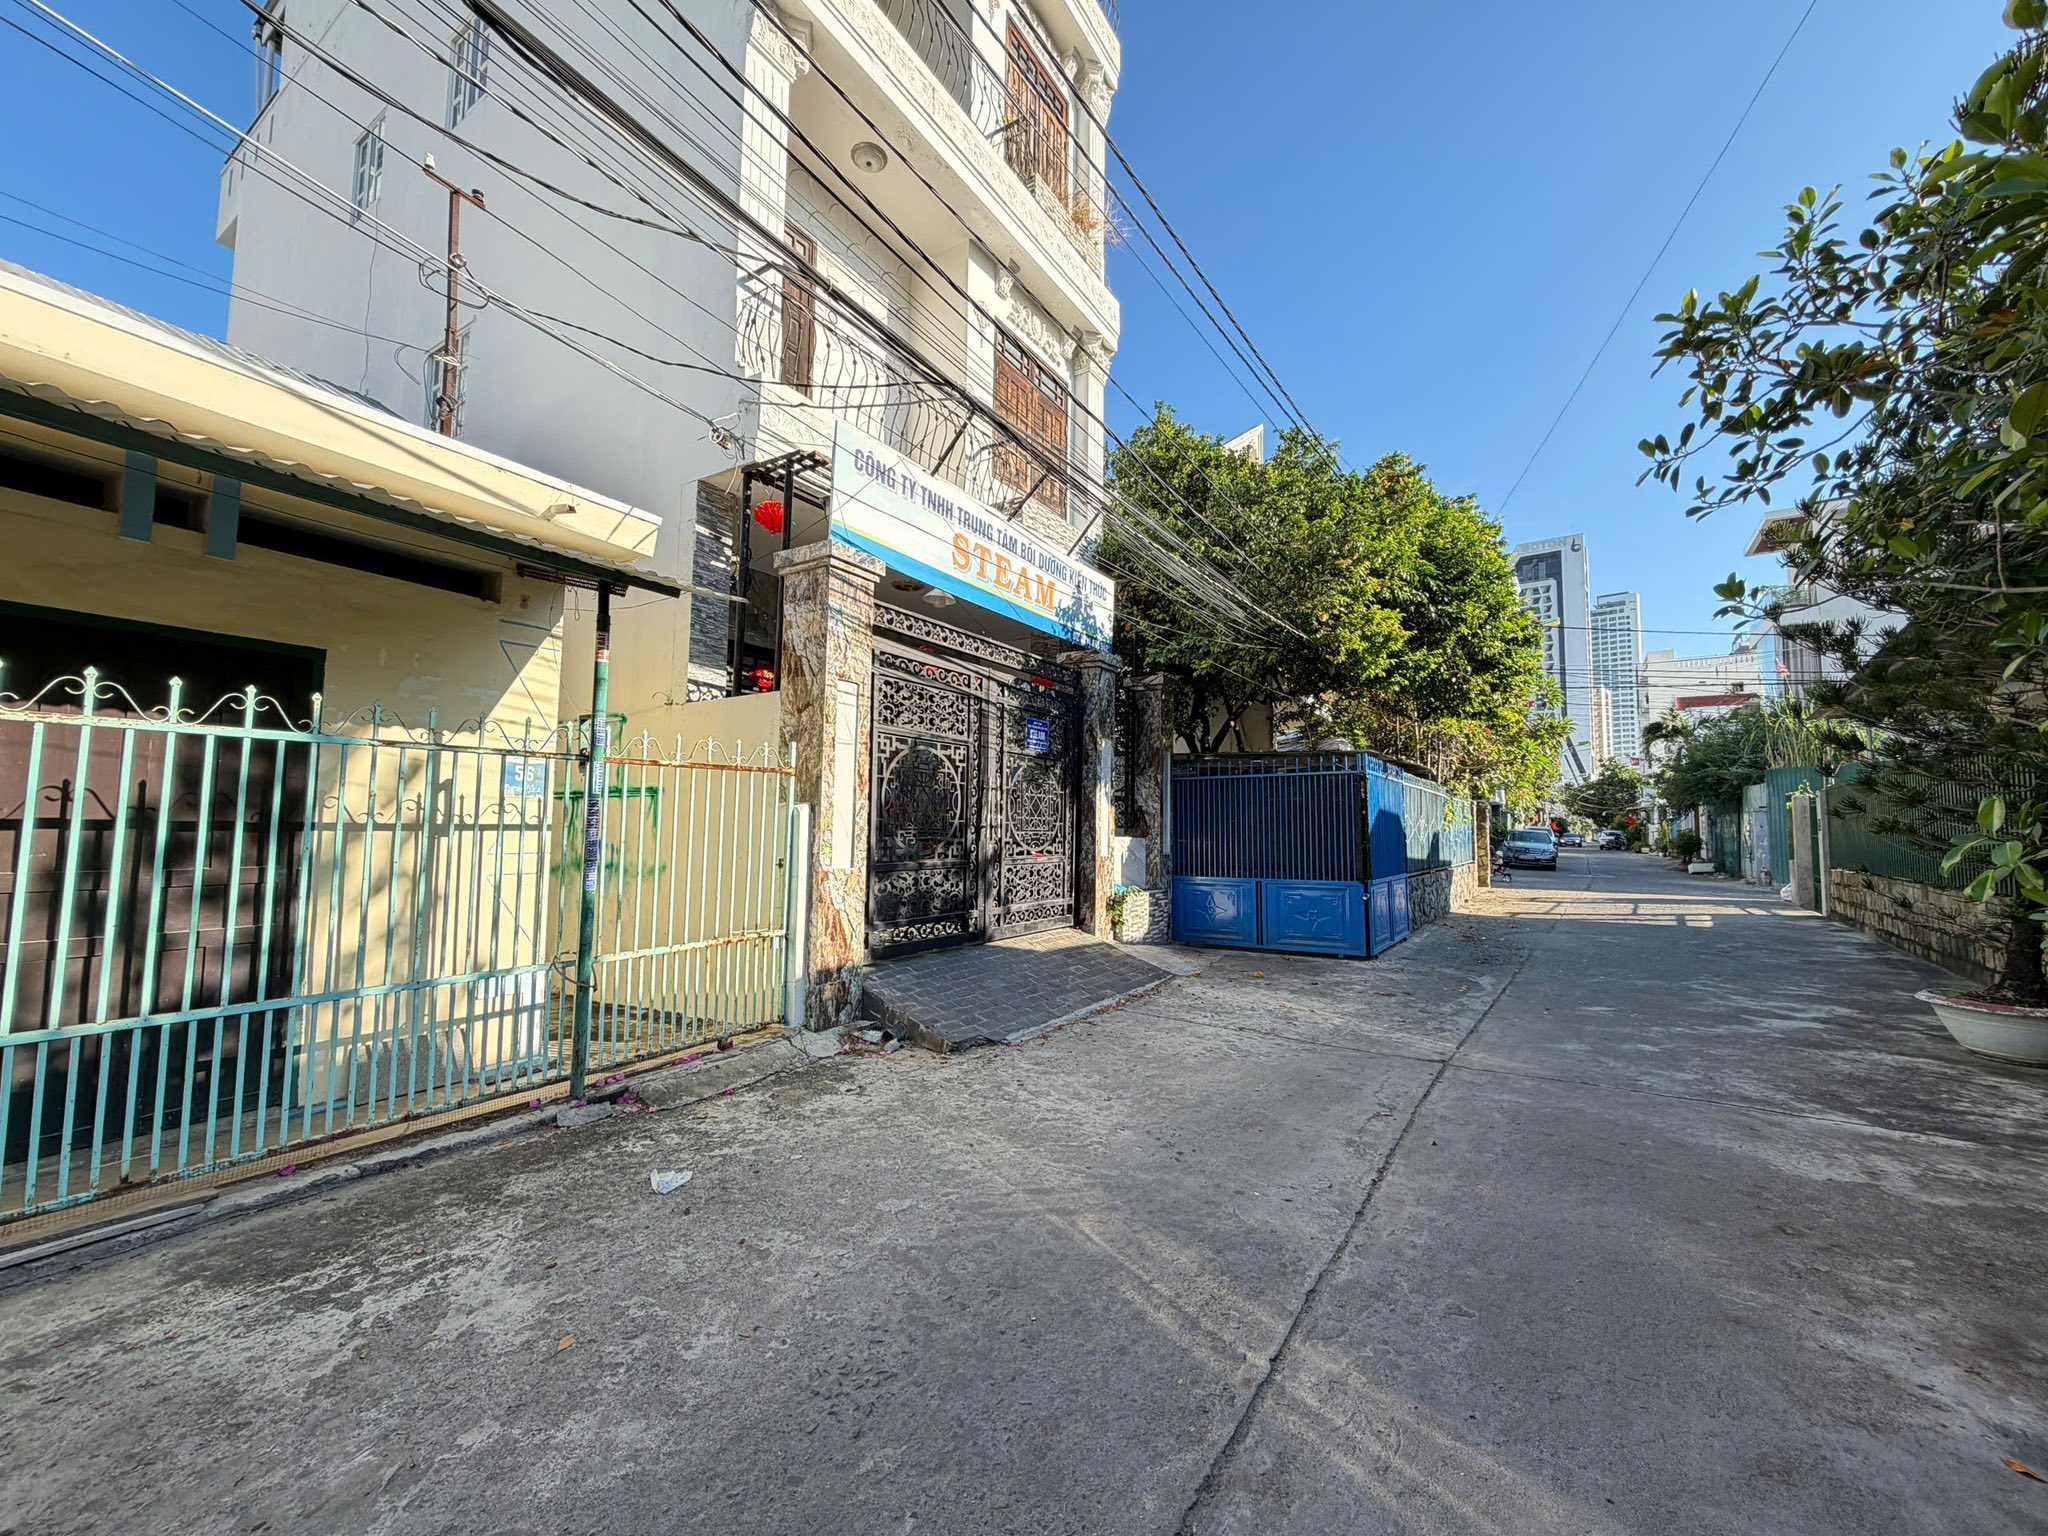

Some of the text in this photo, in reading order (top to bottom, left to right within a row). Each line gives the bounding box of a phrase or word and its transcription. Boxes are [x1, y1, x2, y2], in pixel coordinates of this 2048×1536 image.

[854, 448, 897, 490] CÔNG
[901, 473, 917, 500] TY
[920, 485, 954, 521] TNHH
[957, 505, 993, 542] TRUNG
[997, 528, 1018, 554] TÂM
[1069, 568, 1088, 592] KIẾN
[1089, 579, 1108, 602] THỨC
[952, 532, 1056, 611] STEAM
